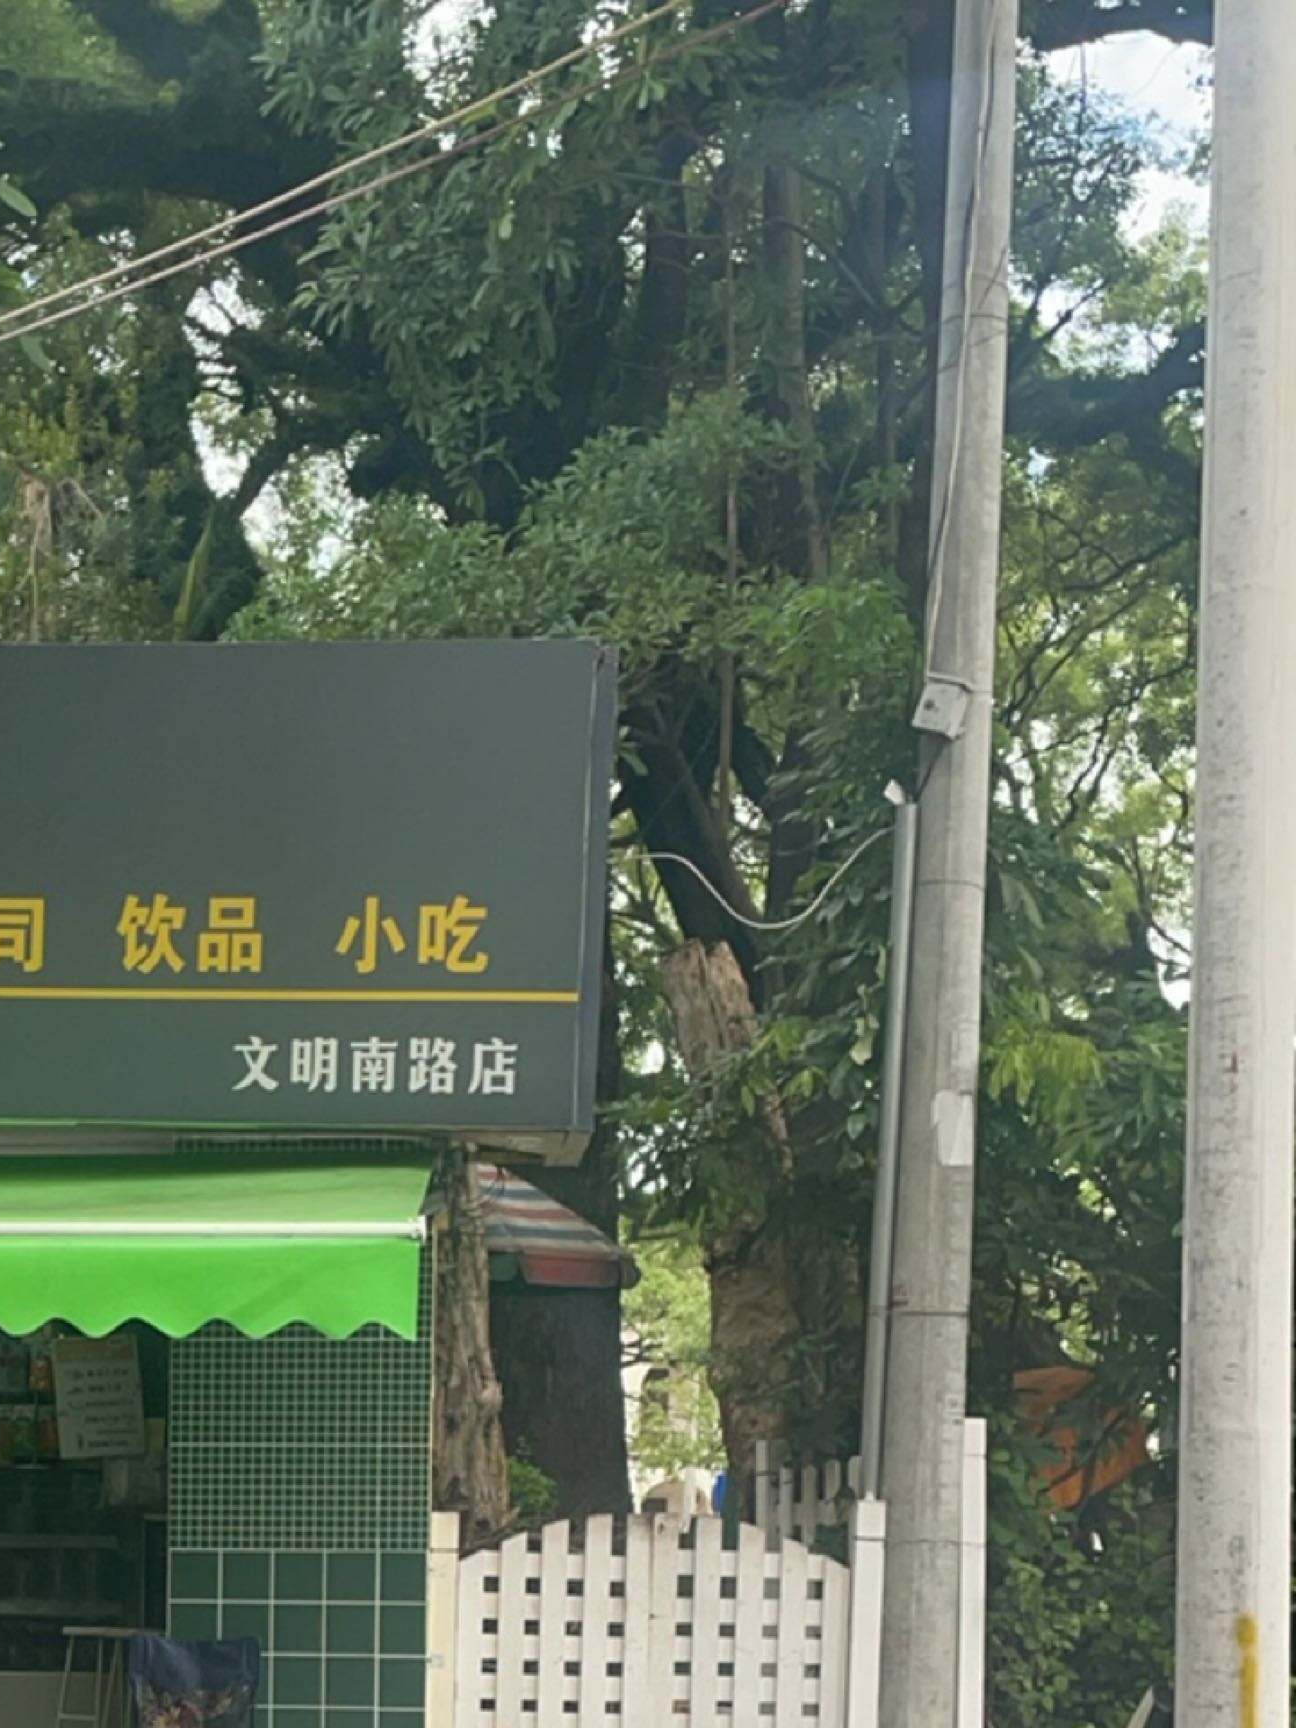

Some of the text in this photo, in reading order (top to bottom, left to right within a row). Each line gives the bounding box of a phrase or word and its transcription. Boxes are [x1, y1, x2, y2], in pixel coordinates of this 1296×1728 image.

[115, 892, 264, 974] 饮品
[334, 894, 490, 974] 小吃
[232, 1036, 519, 1095] 文明南路店
